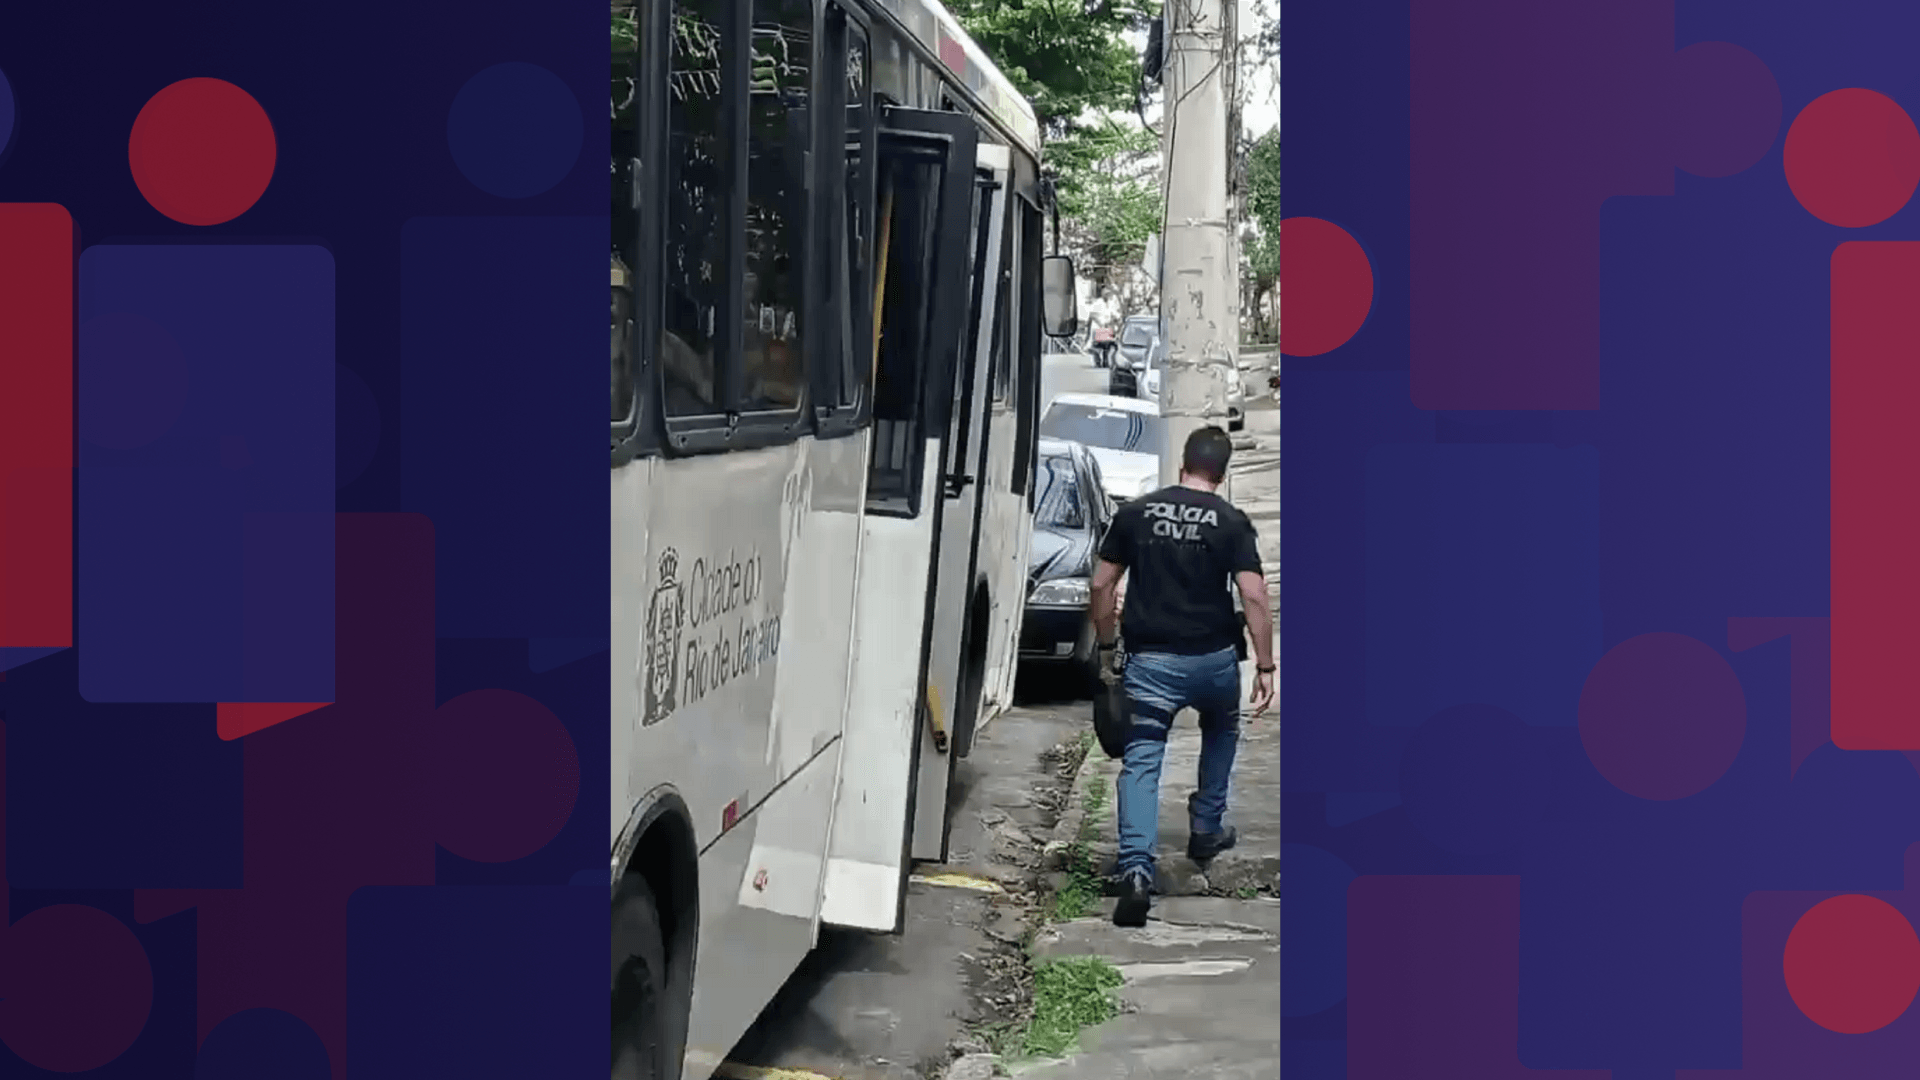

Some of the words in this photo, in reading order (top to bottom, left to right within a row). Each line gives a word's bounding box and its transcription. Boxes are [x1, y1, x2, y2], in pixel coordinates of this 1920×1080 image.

[1152, 519, 1202, 541] CIVIL
[690, 549, 741, 629] Cidade
[683, 635, 708, 708] Rio
[711, 627, 730, 690] de
